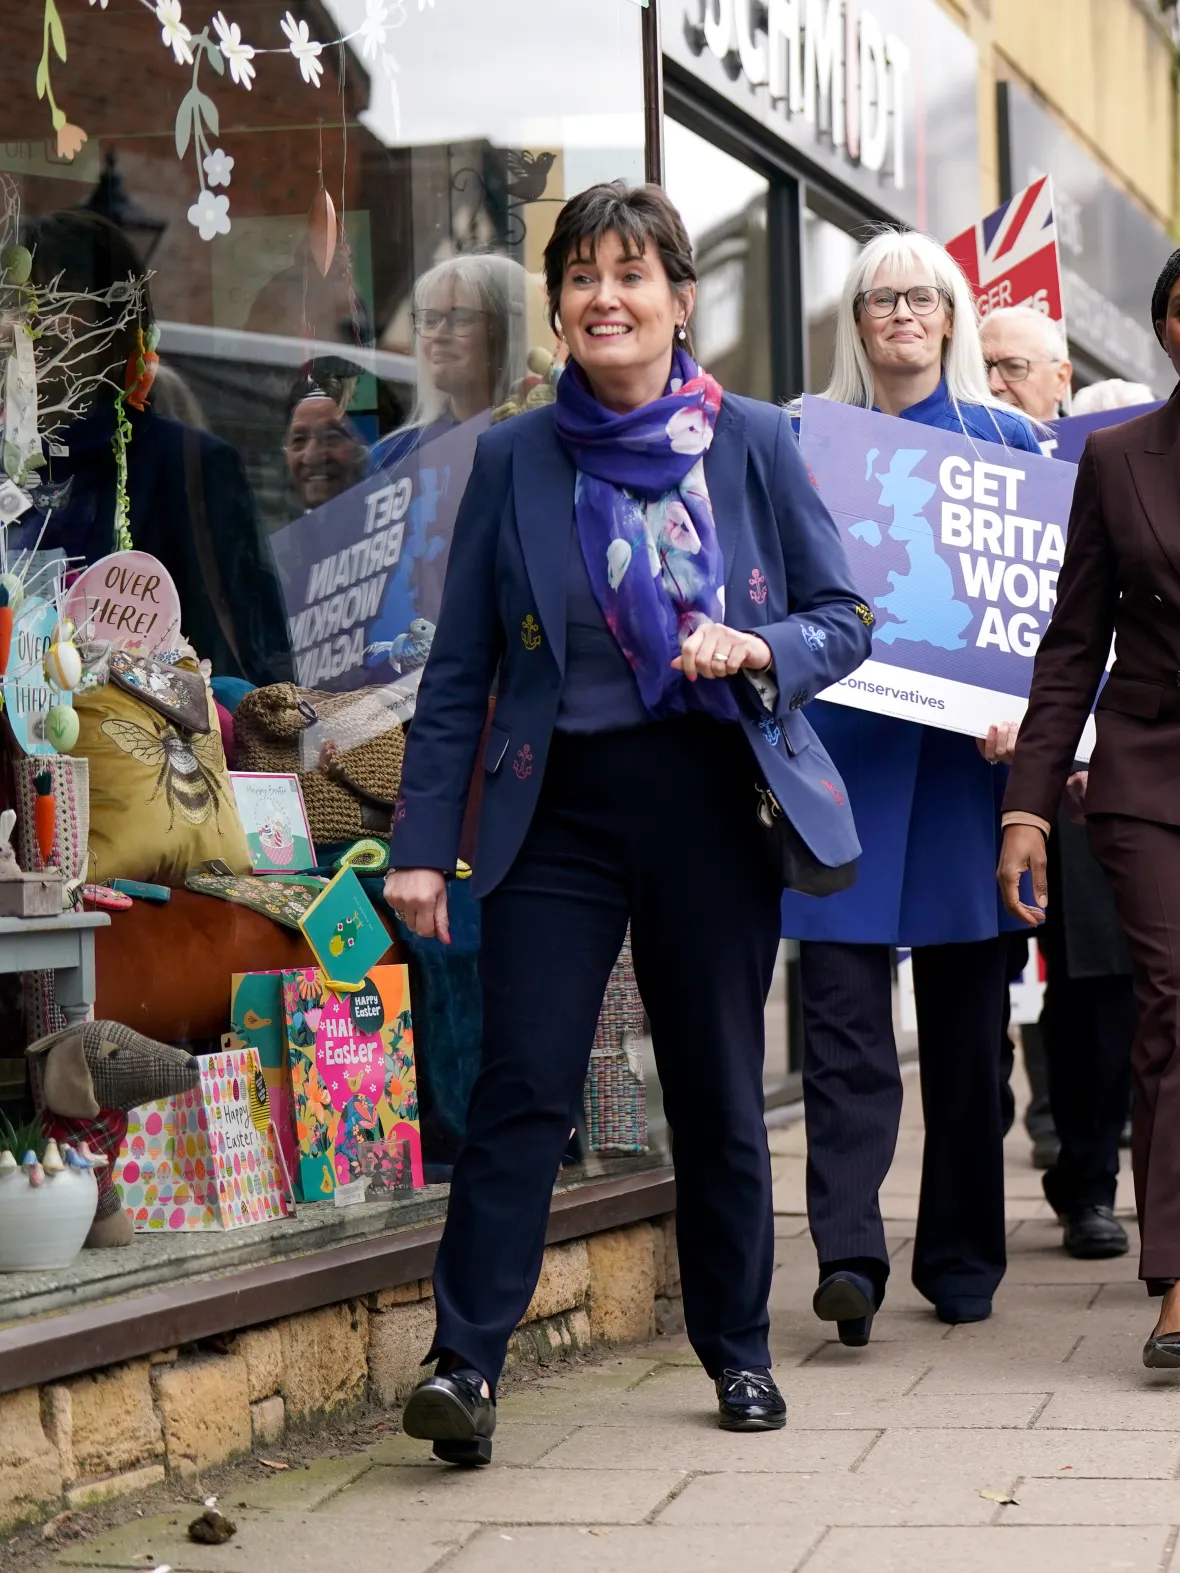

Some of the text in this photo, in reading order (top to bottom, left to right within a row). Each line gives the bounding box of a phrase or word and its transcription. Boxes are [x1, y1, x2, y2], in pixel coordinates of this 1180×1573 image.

[703, 0, 909, 191] CHMIDT
[939, 455, 1025, 511] GET
[941, 501, 1067, 567] BRITA
[104, 566, 160, 603] OVER
[88, 598, 158, 638] HERE!
[14, 676, 60, 713] THERE
[354, 995, 378, 1006] HAPPY
[354, 1005, 380, 1018] Easter
[325, 1041, 378, 1066] Easter
[224, 1105, 250, 1129] Happy
[225, 1131, 259, 1149] Easter!
